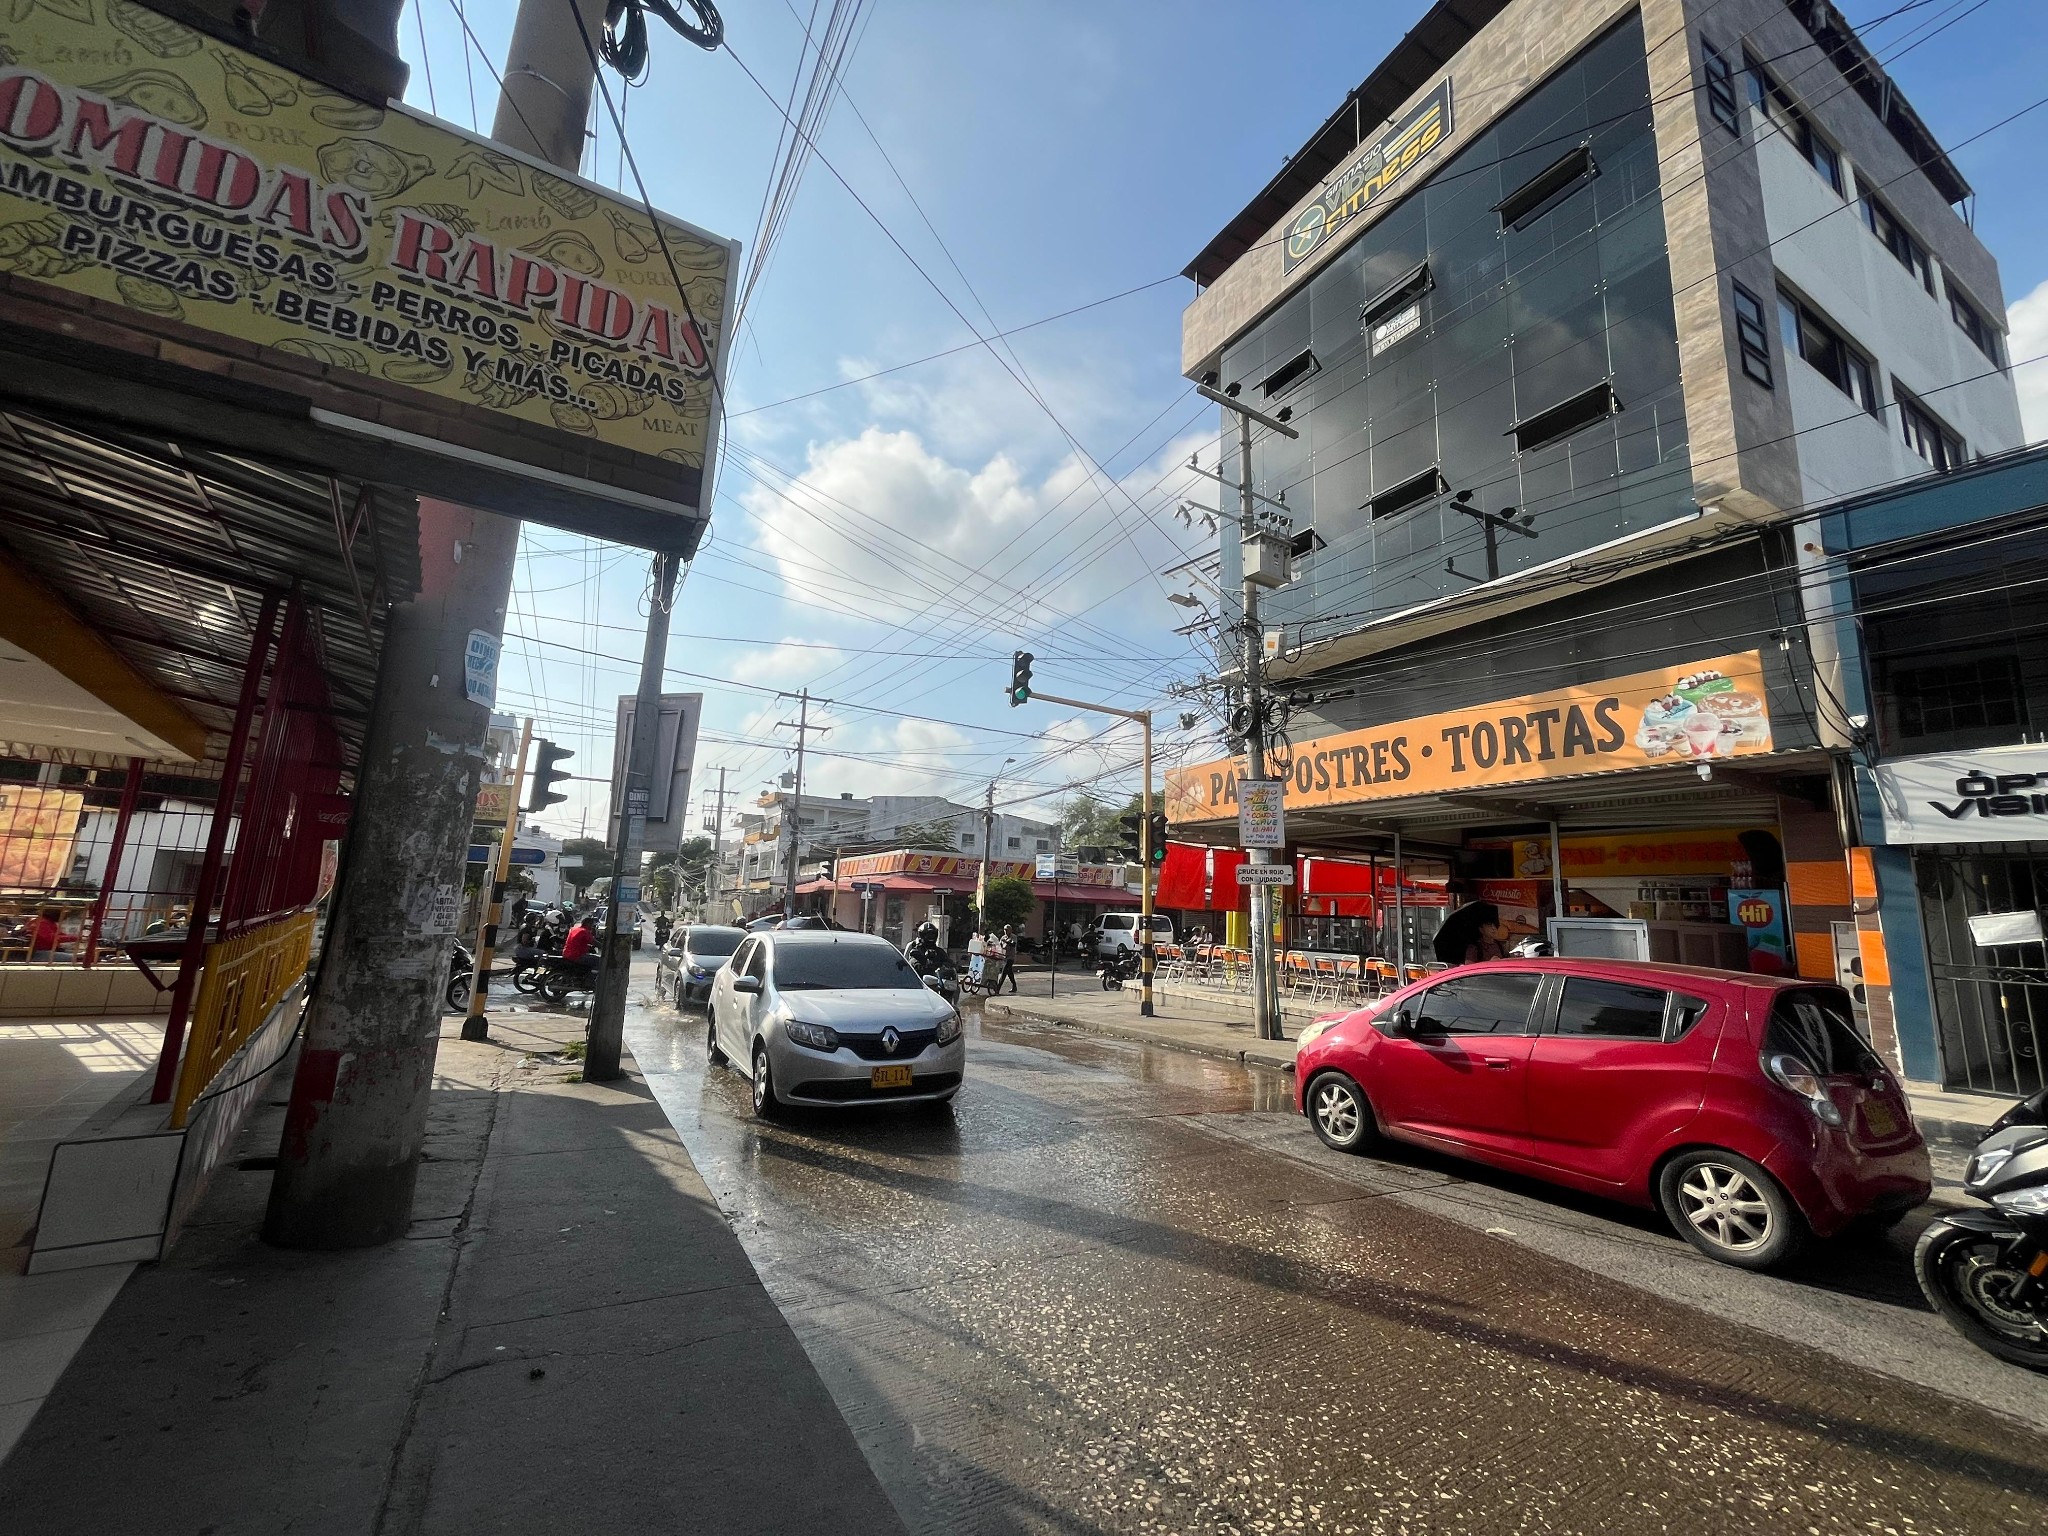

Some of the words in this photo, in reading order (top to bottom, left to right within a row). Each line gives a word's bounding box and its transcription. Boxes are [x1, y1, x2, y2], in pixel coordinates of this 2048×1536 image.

[0, 160, 335, 288] MBURGUESAS
[370, 280, 521, 347] PERROS
[550, 338, 685, 401] PICADAS
[63, 224, 237, 297] PIZZAS
[275, 288, 449, 363] BEBIDAS
[462, 346, 487, 371] Y
[390, 211, 711, 371] RAPIDAS
[642, 416, 699, 437] MEAT
[1280, 736, 1412, 797] POSTRES
[1441, 697, 1626, 773] TORTAS
[1927, 794, 2048, 819] VISI
[1483, 883, 1522, 901] Exquisito
